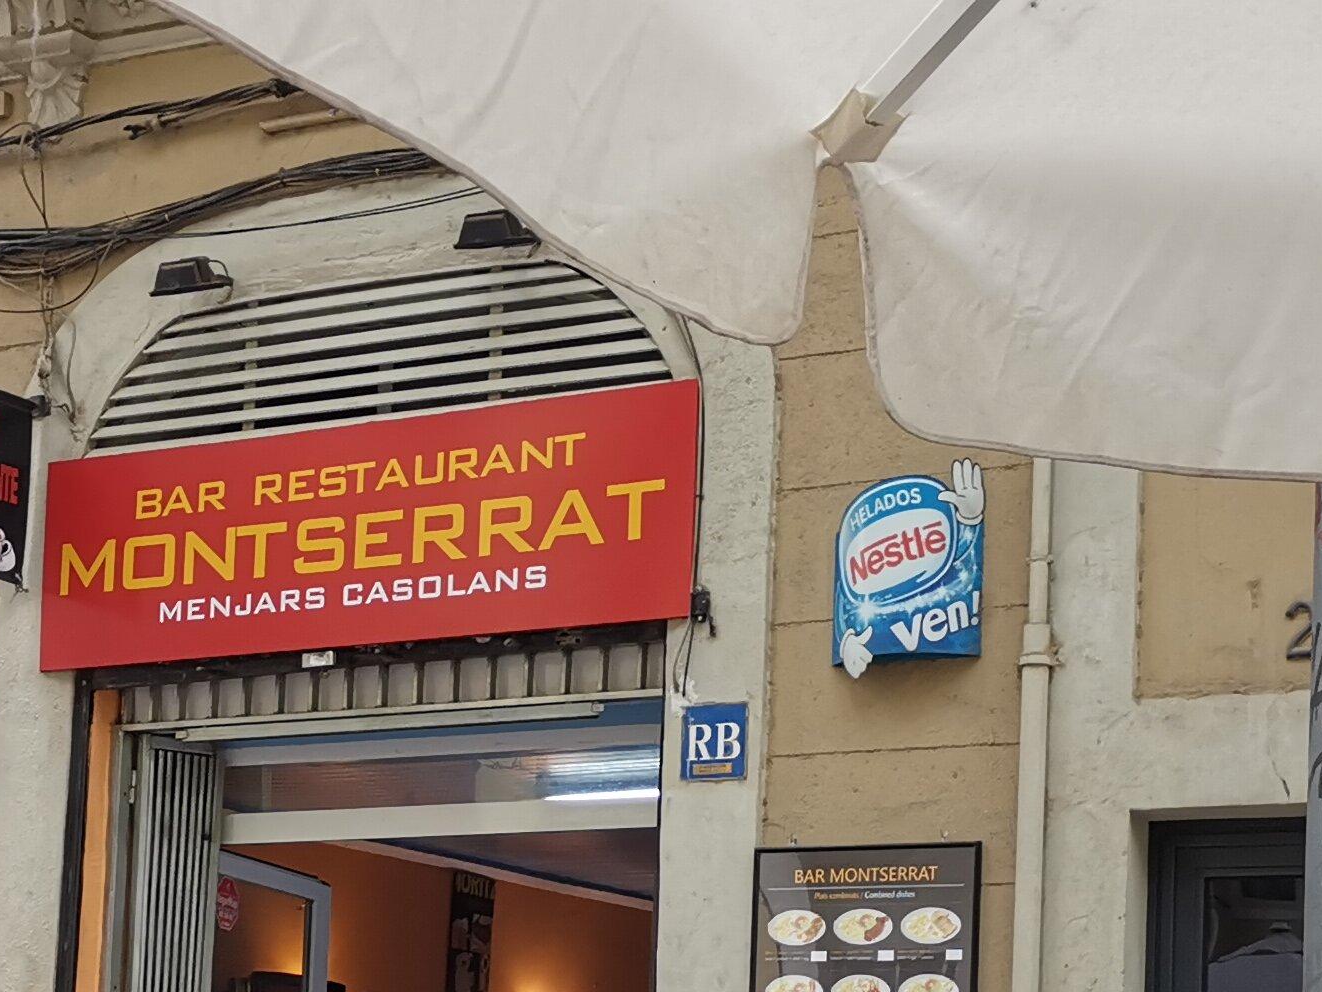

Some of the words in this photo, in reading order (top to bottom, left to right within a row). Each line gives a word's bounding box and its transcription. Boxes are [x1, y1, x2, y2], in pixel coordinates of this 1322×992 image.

[134, 480, 226, 521] BAR
[254, 432, 588, 506] RESTAURANT
[58, 478, 667, 597] MONTSERRAT
[849, 487, 922, 531] HELADOS
[158, 586, 326, 624] MENJARS
[342, 564, 548, 608] CASOLANS
[890, 590, 981, 652] ven!
[686, 722, 741, 761] RB
[794, 869, 824, 884] BAR
[830, 865, 938, 883] MONTSERRAT
